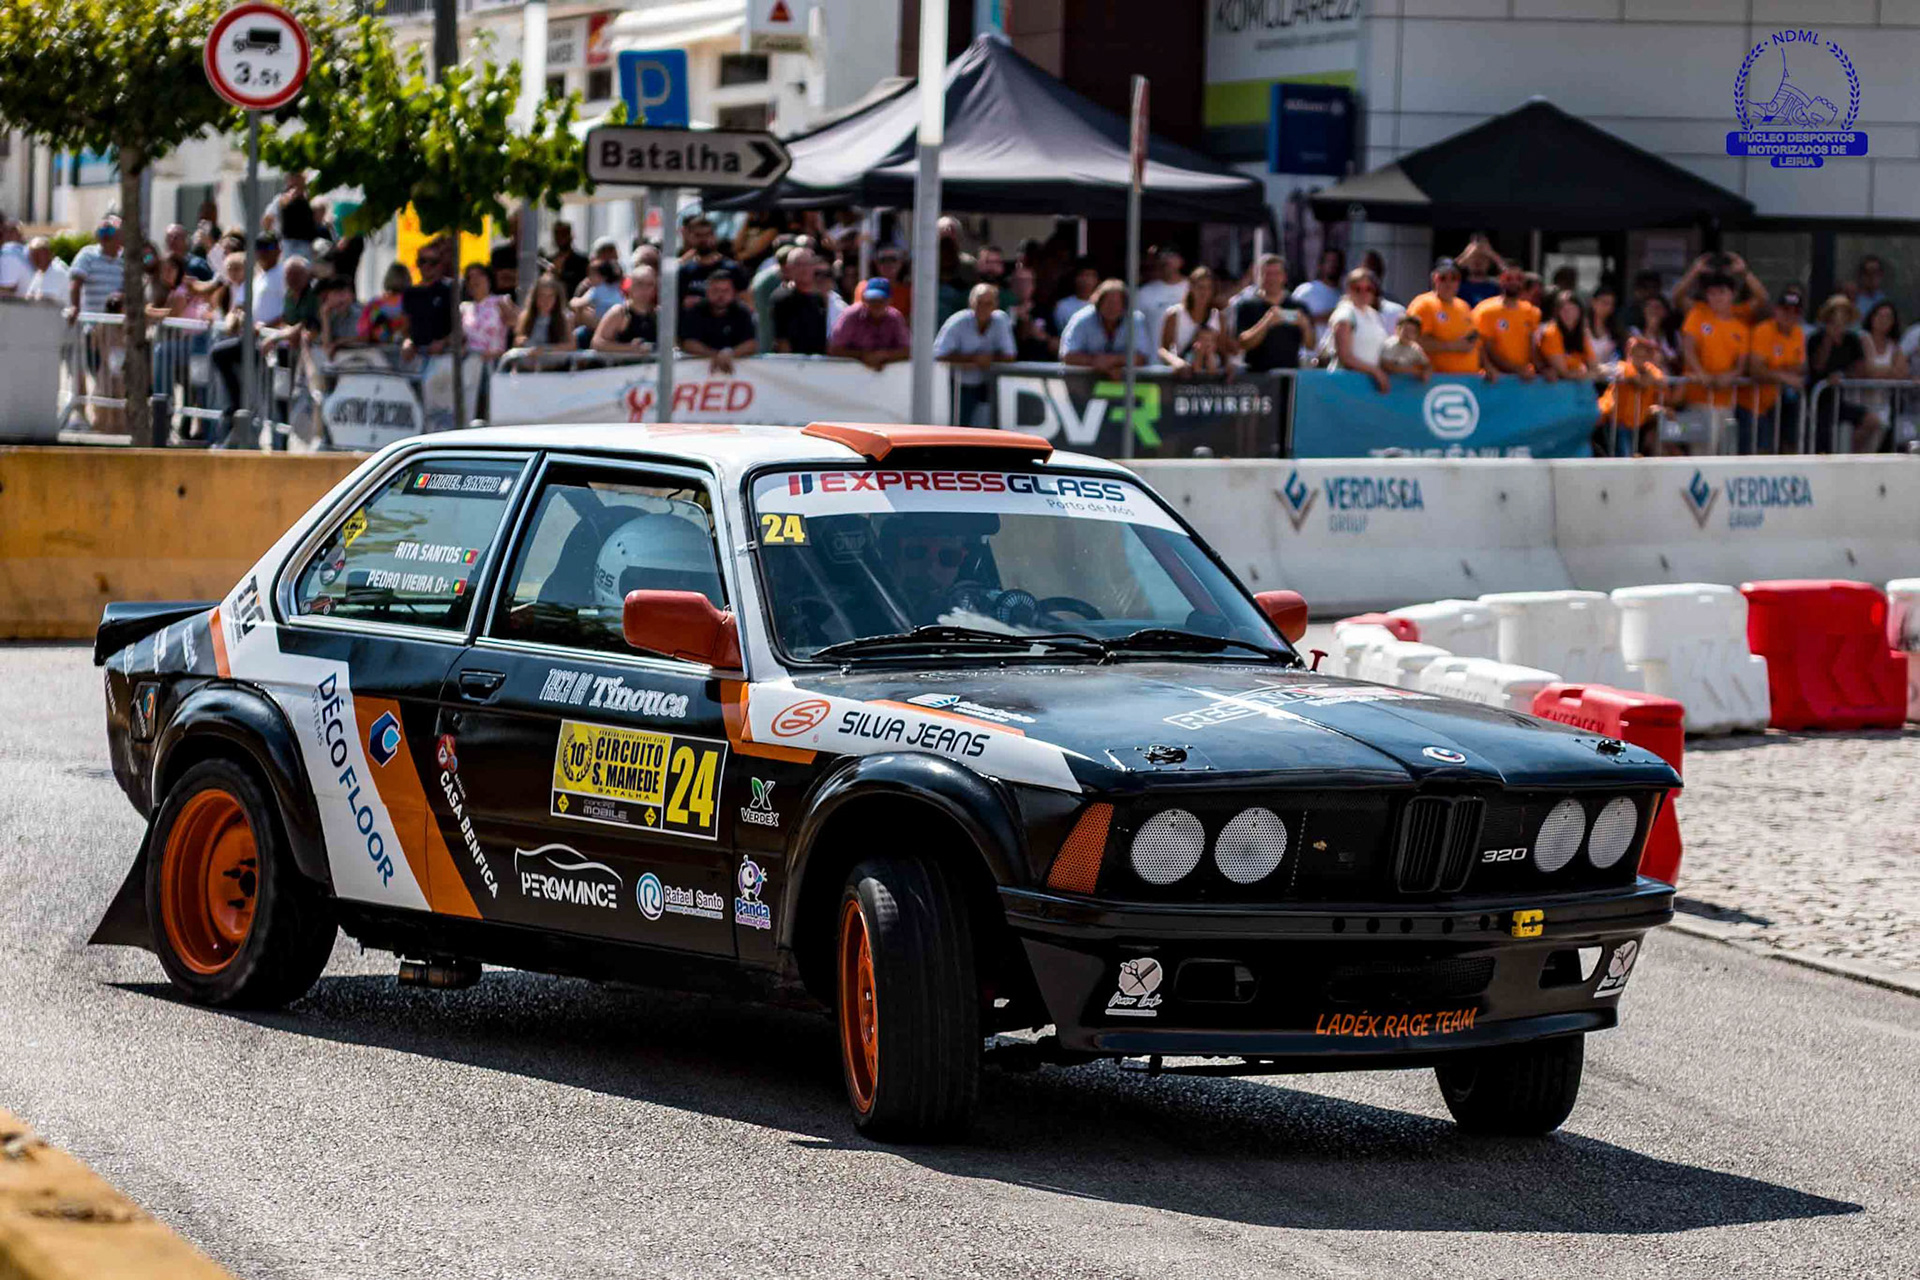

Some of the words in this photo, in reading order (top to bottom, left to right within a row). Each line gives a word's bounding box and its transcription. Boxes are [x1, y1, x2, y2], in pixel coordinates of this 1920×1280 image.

[634, 60, 672, 122] P
[600, 140, 743, 174] Batalha
[996, 375, 1162, 447] DVR
[1174, 396, 1273, 415] DIVIREIS
[1045, 498, 1086, 511] Porto
[1087, 502, 1106, 513] de
[1325, 477, 1425, 511] VERDASCA
[1725, 475, 1813, 508] VERDASCA
[761, 514, 806, 544] 24
[395, 541, 419, 560] RITA
[419, 543, 463, 564] SANTOS
[366, 569, 400, 589] PEDRO
[401, 571, 434, 593] VIEIRA
[588, 676, 690, 718] Tinouca
[311, 688, 324, 747] SYSTEMS
[838, 711, 902, 744] SILVA
[907, 722, 991, 758] JEANS
[595, 736, 665, 769] CIRCUITO
[318, 672, 348, 768] DÉCO
[339, 765, 395, 888] FLOOR
[592, 762, 604, 786] S.
[605, 764, 661, 795] MAMEDE
[598, 787, 651, 801] BATALHA
[666, 745, 720, 828] 24
[440, 770, 463, 821] CASA
[459, 818, 500, 899] BENFICA
[1481, 848, 1528, 863] 320
[664, 885, 694, 907] Rafael
[696, 889, 724, 911] Santo
[735, 898, 770, 919] Panda
[1315, 1009, 1383, 1039] LADÉX
[1435, 1006, 1478, 1034] TEAM
